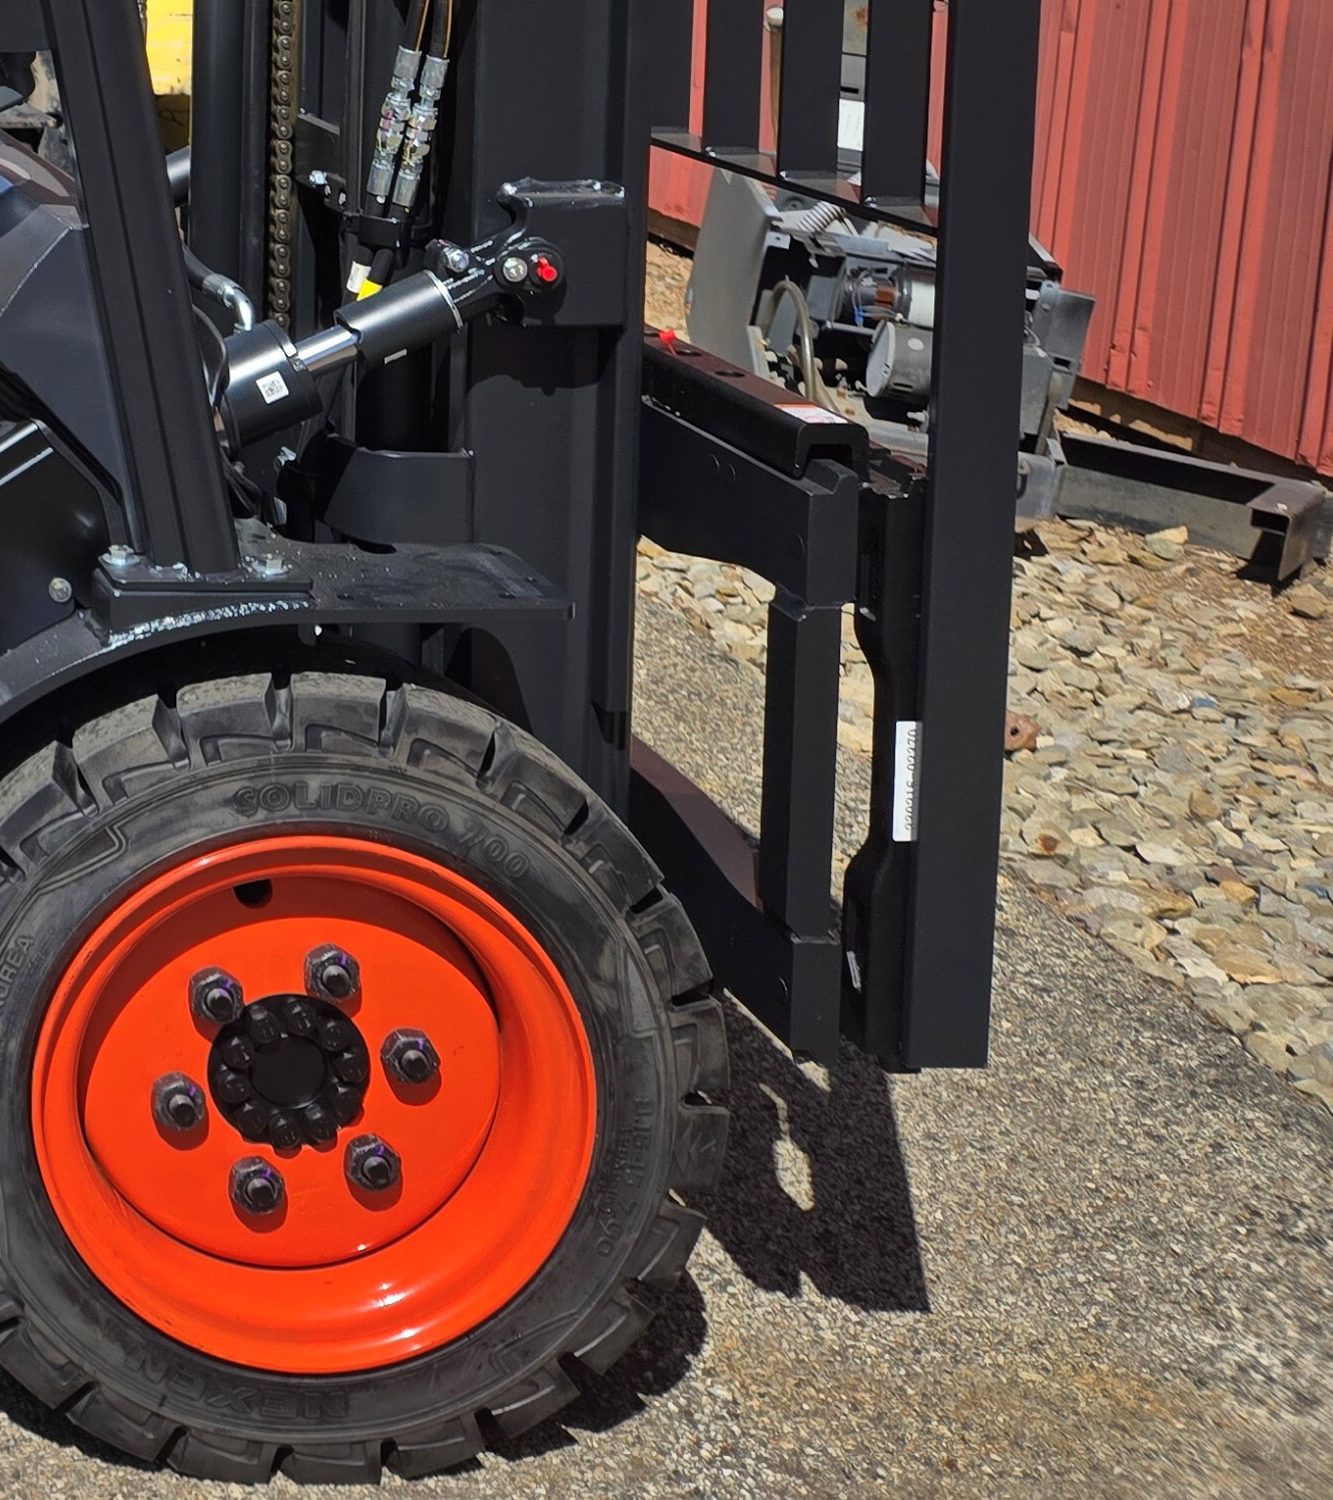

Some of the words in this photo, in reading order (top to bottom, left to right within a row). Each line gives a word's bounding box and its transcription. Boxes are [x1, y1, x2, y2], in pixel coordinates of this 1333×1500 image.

[234, 781, 449, 832] SOLIDPRO
[459, 819, 530, 879] 700
[126, 1350, 352, 1420] NEXEN
